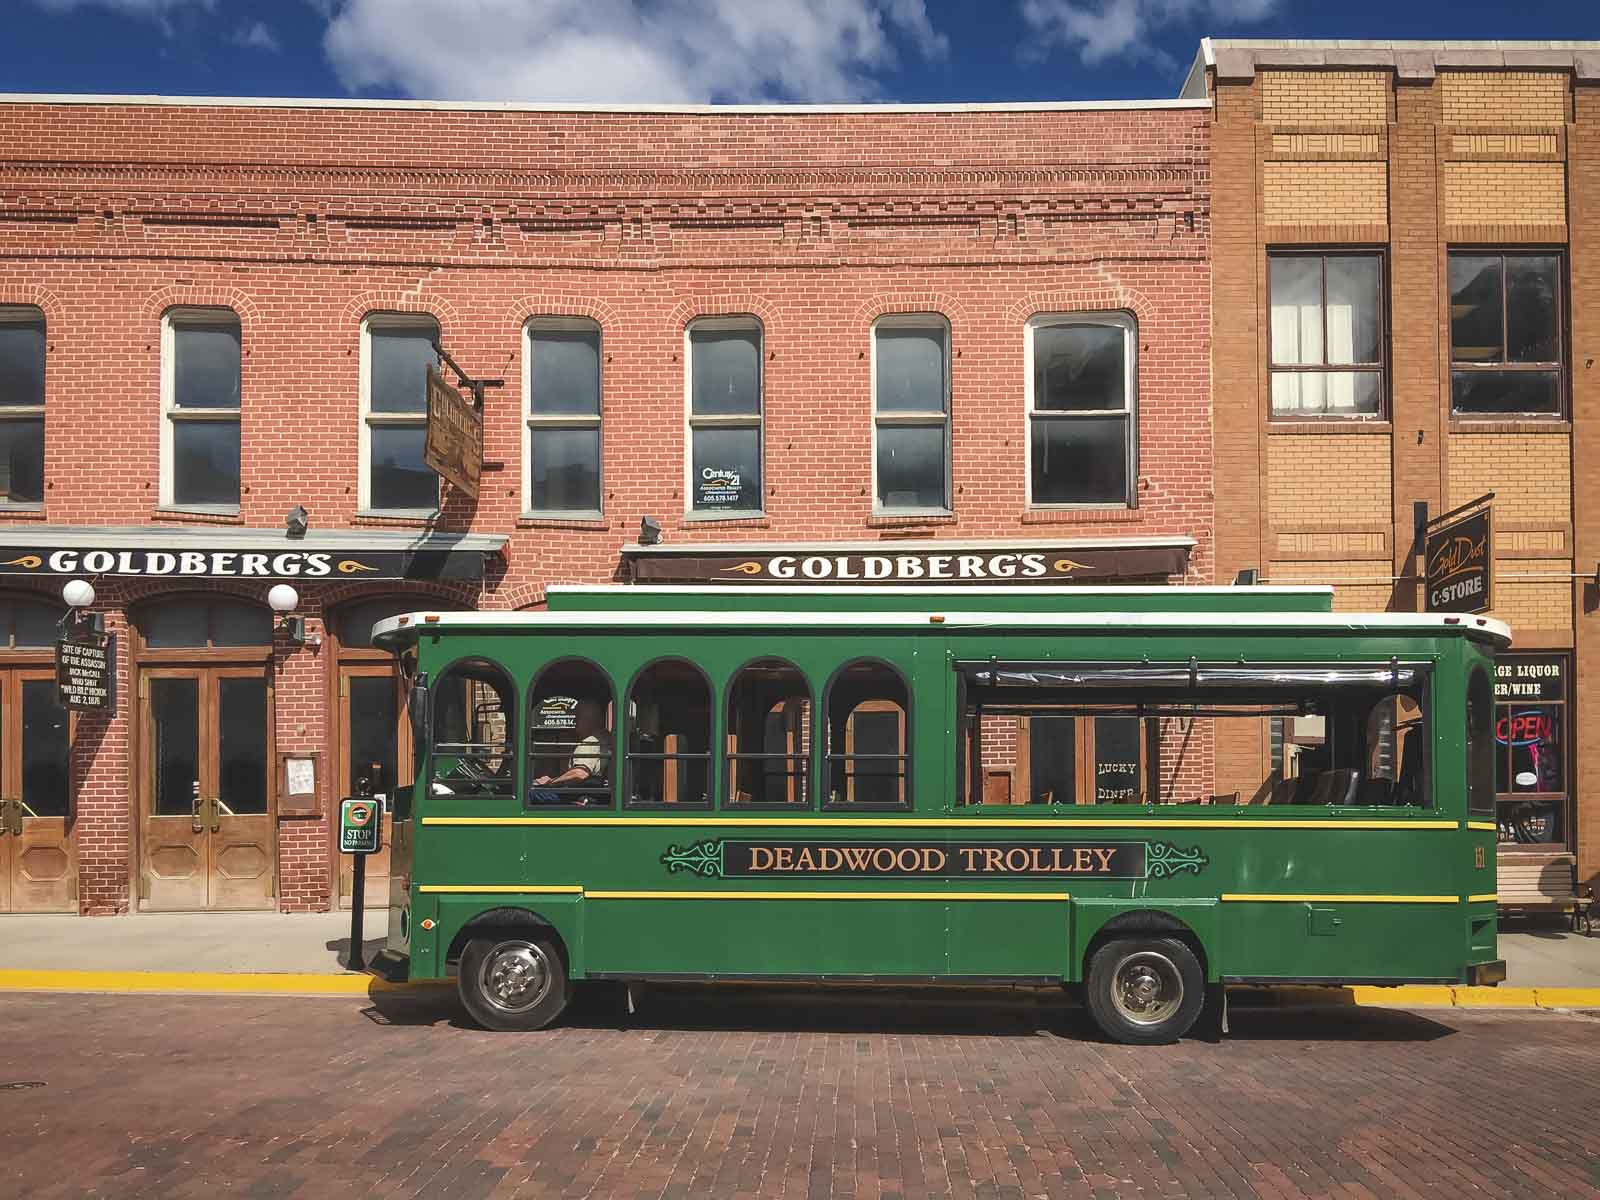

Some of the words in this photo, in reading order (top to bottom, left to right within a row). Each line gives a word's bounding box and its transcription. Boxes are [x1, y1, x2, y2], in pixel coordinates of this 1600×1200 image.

[730, 475, 741, 485] 21
[1449, 534, 1487, 573] Dust
[48, 550, 332, 576] GOLDBERG'S
[767, 553, 1048, 579] GOLDBERG'S
[62, 645, 74, 654] SITE
[74, 646, 82, 655] OF
[82, 648, 105, 658] CAPTURE
[62, 656, 70, 664] OF
[70, 656, 80, 665] THE
[81, 658, 106, 669] ASSASSIN
[69, 668, 81, 676] JACK
[82, 669, 100, 678] McCALL
[1517, 665, 1560, 678] LIQUOR
[72, 677, 84, 686] WHO
[89, 687, 107, 697] HICKOK
[1496, 716, 1552, 739] OPEN
[1098, 763, 1137, 775] LUCKY
[347, 829, 371, 839] STOP
[748, 847, 946, 872] DEADWOOD
[959, 847, 1117, 872] TROLLEY
